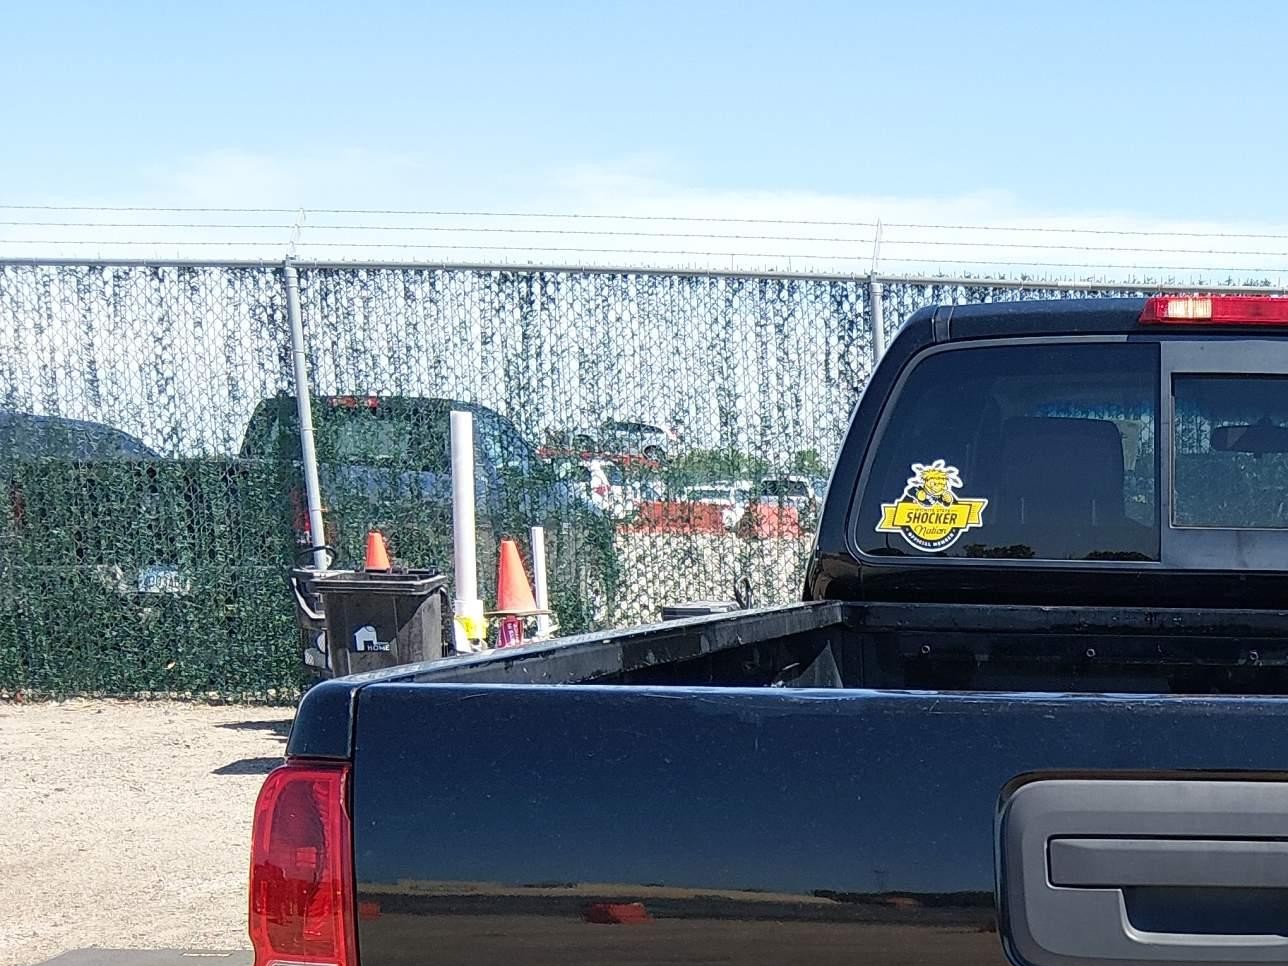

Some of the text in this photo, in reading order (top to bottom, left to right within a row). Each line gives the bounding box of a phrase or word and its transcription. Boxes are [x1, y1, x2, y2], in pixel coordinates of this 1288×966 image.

[906, 512, 957, 524] SHOCKER
[914, 525, 946, 536] Nation
[908, 532, 931, 547] OFFICIAL
